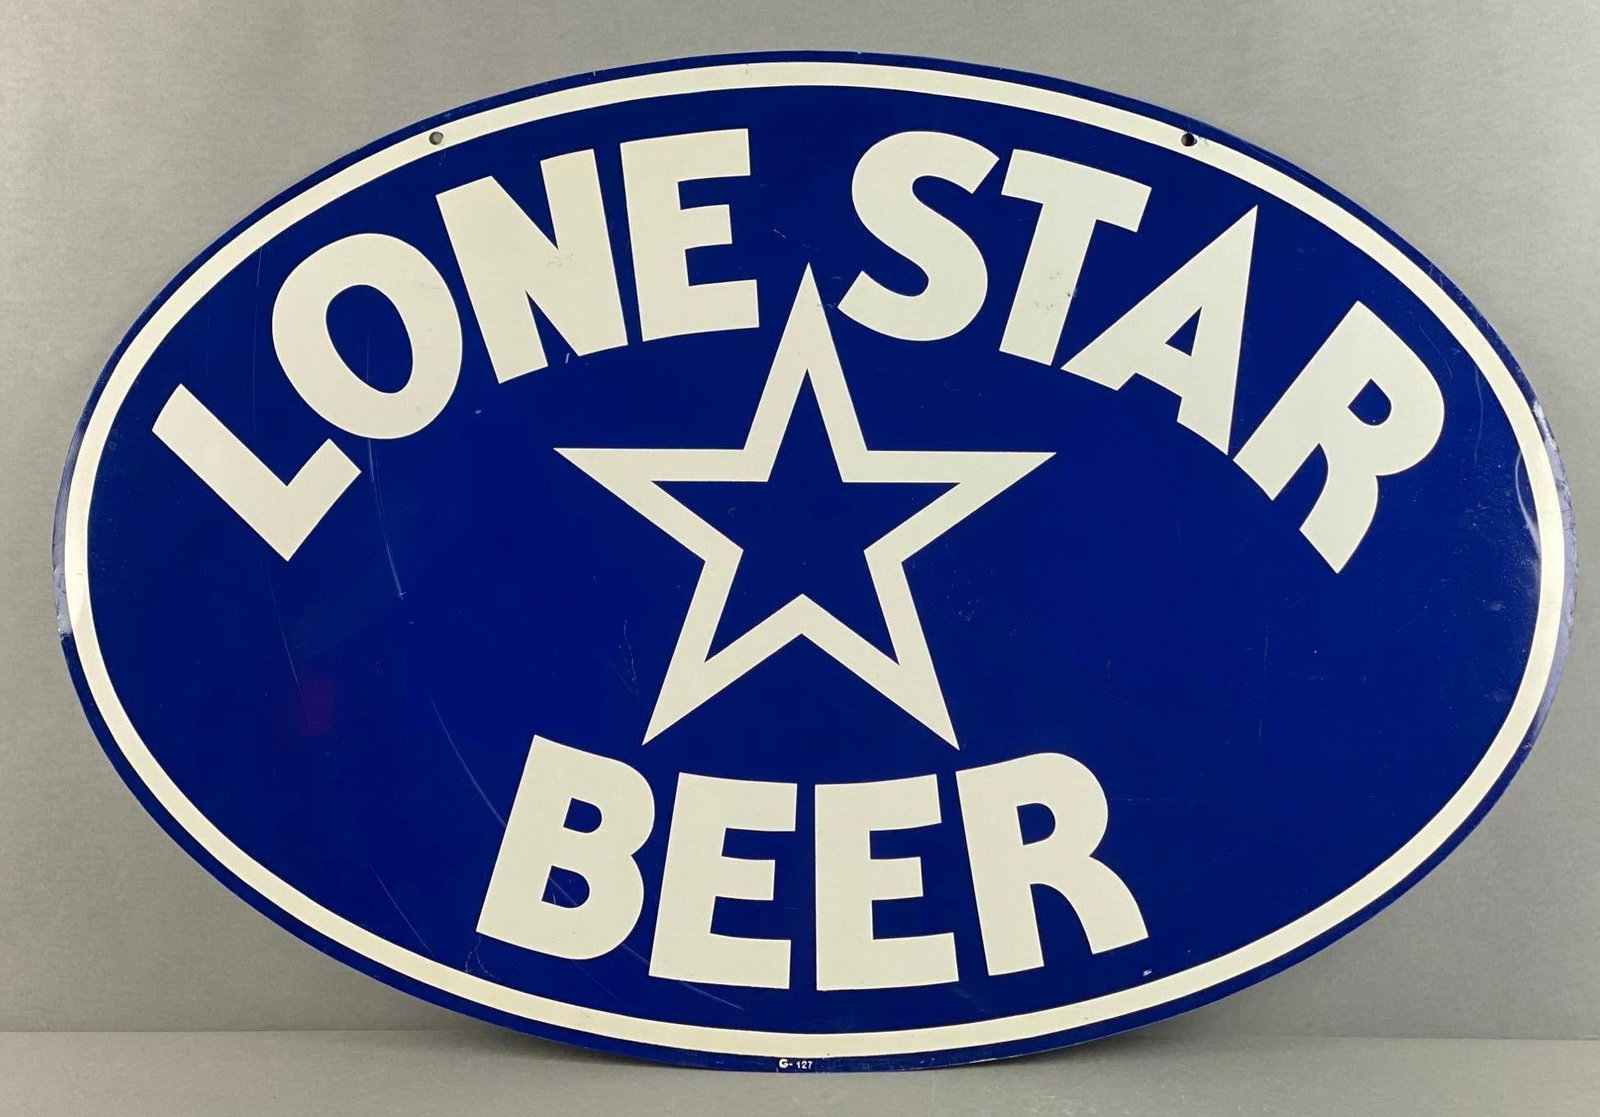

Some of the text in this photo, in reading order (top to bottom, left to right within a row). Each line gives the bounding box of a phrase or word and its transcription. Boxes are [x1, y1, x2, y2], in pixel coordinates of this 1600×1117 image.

[152, 129, 1444, 573] LONE STAR
[476, 735, 1148, 991] BEER
